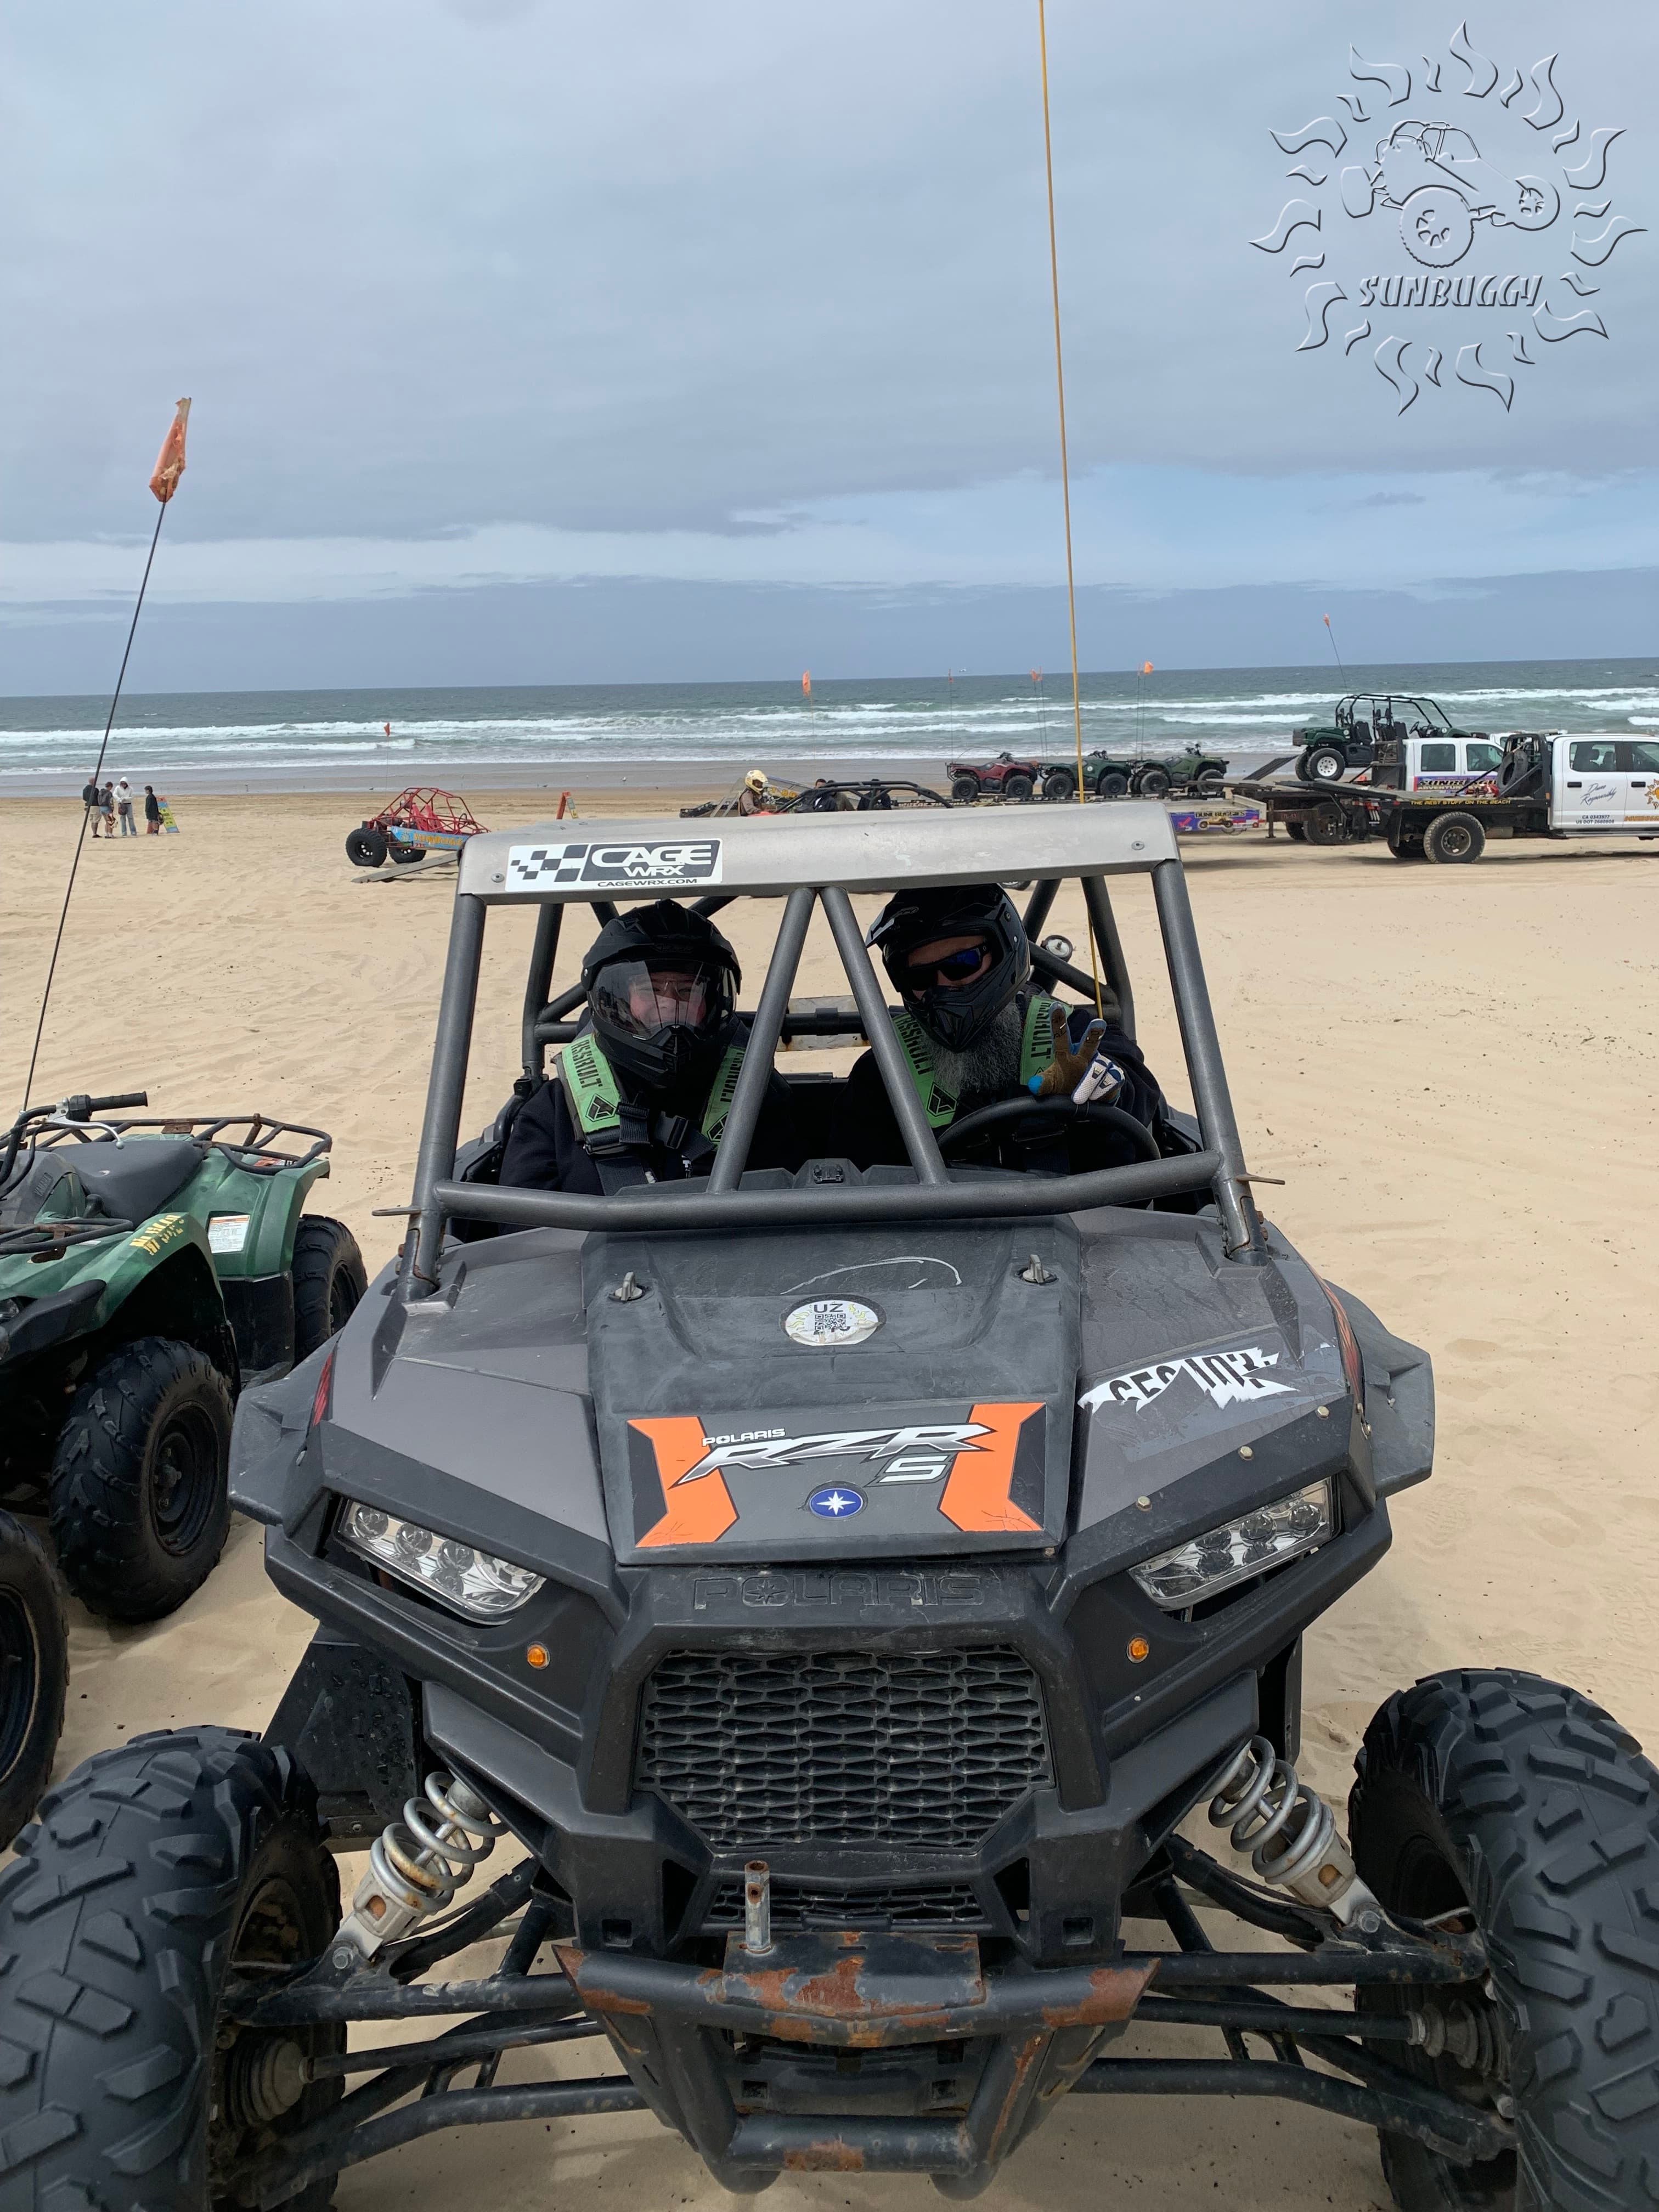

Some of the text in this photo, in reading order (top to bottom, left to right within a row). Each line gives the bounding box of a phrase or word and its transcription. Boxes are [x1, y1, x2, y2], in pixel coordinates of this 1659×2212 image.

[591, 844, 712, 868] CAGE
[597, 878, 697, 888] CAGEWRX.COM
[623, 865, 685, 877] WRX
[571, 1040, 603, 1088] ASSAULT
[814, 1303, 843, 1313] UZ
[702, 1427, 786, 1446] POLARIS
[674, 1423, 994, 1486] RZR
[879, 1454, 949, 1483] S
[693, 1572, 984, 1610] POLARIS
